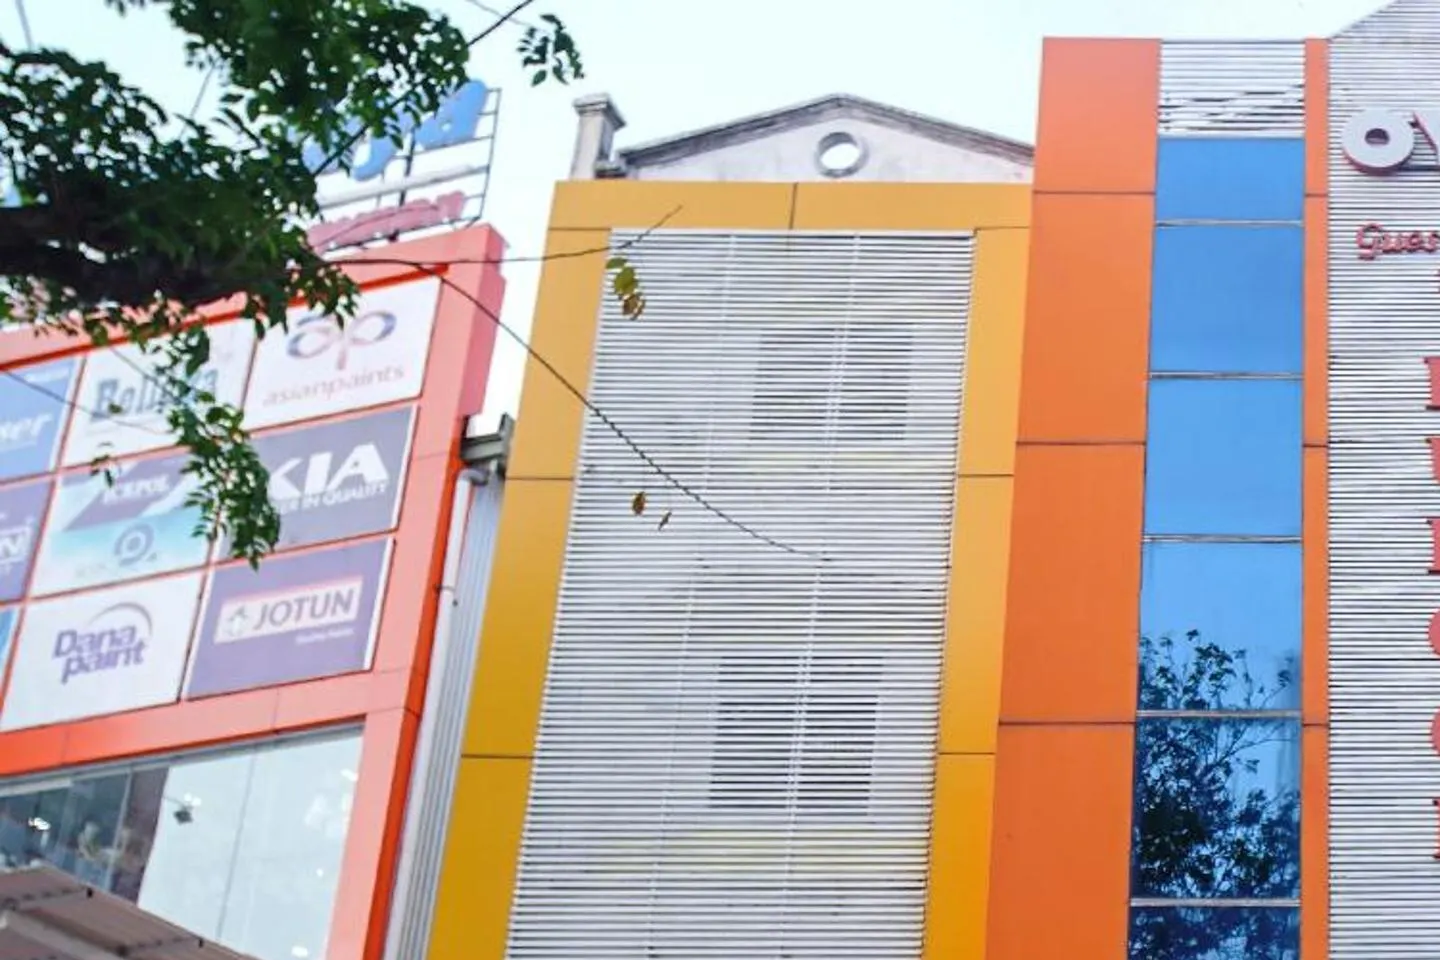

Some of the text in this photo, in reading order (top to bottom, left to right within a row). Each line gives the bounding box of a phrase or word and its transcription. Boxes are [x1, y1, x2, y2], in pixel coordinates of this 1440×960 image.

[253, 588, 354, 631] JOTUN
[54, 624, 137, 659] Dana
[60, 637, 145, 686] paint
